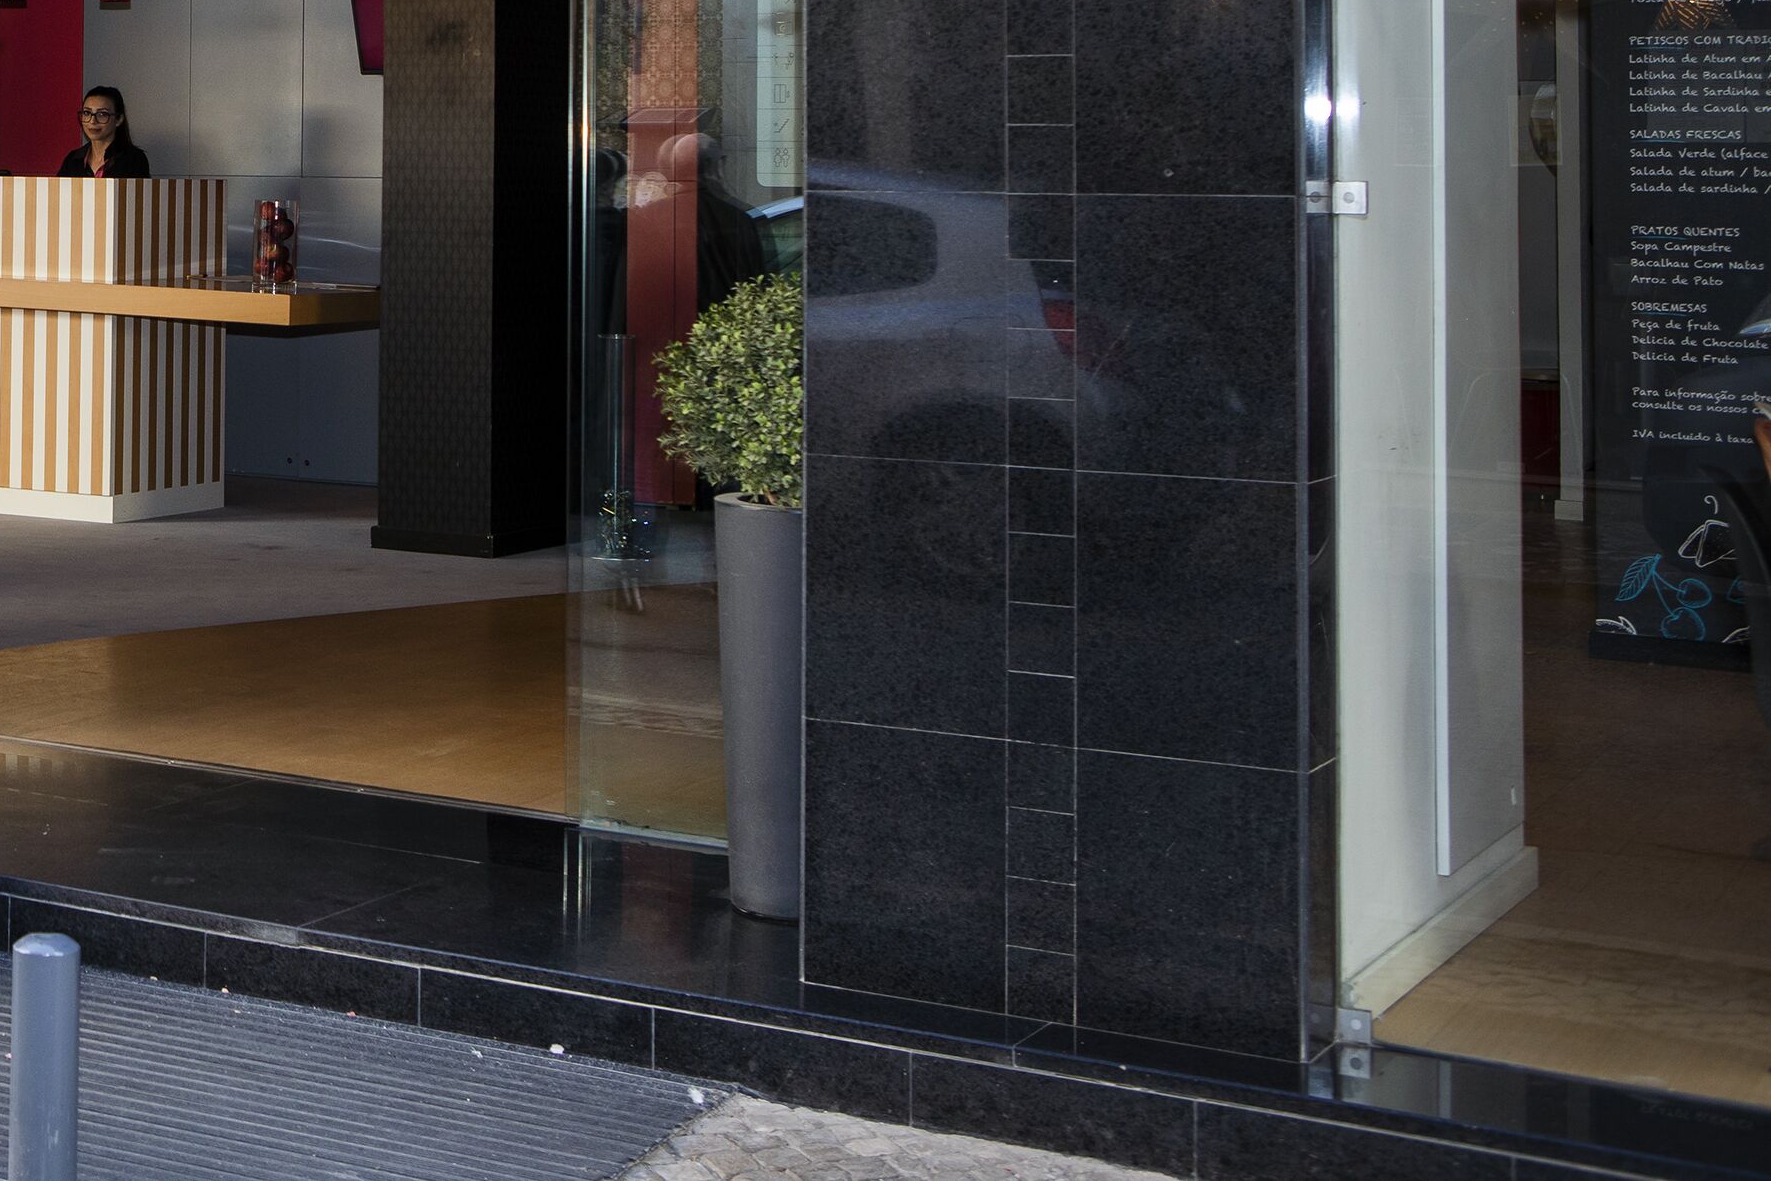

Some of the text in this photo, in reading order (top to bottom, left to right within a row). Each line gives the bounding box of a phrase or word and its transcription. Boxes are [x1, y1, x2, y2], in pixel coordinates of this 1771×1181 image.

[1629, 36, 1689, 45] PETISCOS
[1694, 35, 1721, 45] COM
[1629, 55, 1676, 64] Latinha
[1681, 53, 1698, 64] de
[1703, 54, 1736, 63] Atum
[1629, 71, 1676, 80] Latinha
[1681, 70, 1698, 80] de
[1703, 70, 1762, 79] Bacalhau
[1629, 87, 1677, 96] Latinha
[1681, 87, 1698, 96] de
[1703, 87, 1759, 96] Sardinha
[1629, 103, 1677, 113] Latinha
[1681, 103, 1698, 113] de
[1703, 103, 1749, 113] Cavala
[1629, 130, 1742, 139] SALADAS FRESCAS
[1630, 147, 1769, 160] Salada Verde (alface
[1630, 166, 1673, 176] Salada
[1679, 167, 1696, 176] de
[1700, 167, 1734, 177] atum
[1630, 183, 1673, 192] Salada
[1678, 183, 1695, 193] de
[1700, 183, 1757, 193] sardinha
[1631, 225, 1740, 237] PRATOS QUENTES
[1631, 241, 1732, 257] Sopa Campestre
[1630, 258, 1765, 270] Bacalhau Com Natas
[1630, 275, 1724, 286] Arroz de Pato
[1631, 302, 1708, 313] SOBREMESAS
[1632, 319, 1721, 332] Peça de fruta
[1681, 337, 1698, 346] de
[1703, 338, 1768, 349] Chocolate
[1681, 352, 1698, 363] de
[1703, 354, 1738, 365] Fruta
[1632, 387, 1771, 405] Para informação sobre
[1632, 400, 1684, 411] consulte
[1688, 404, 1702, 412] os
[1706, 404, 1748, 414] nossos
[1632, 429, 1655, 439] IVA
[1728, 435, 1754, 444] taxa
